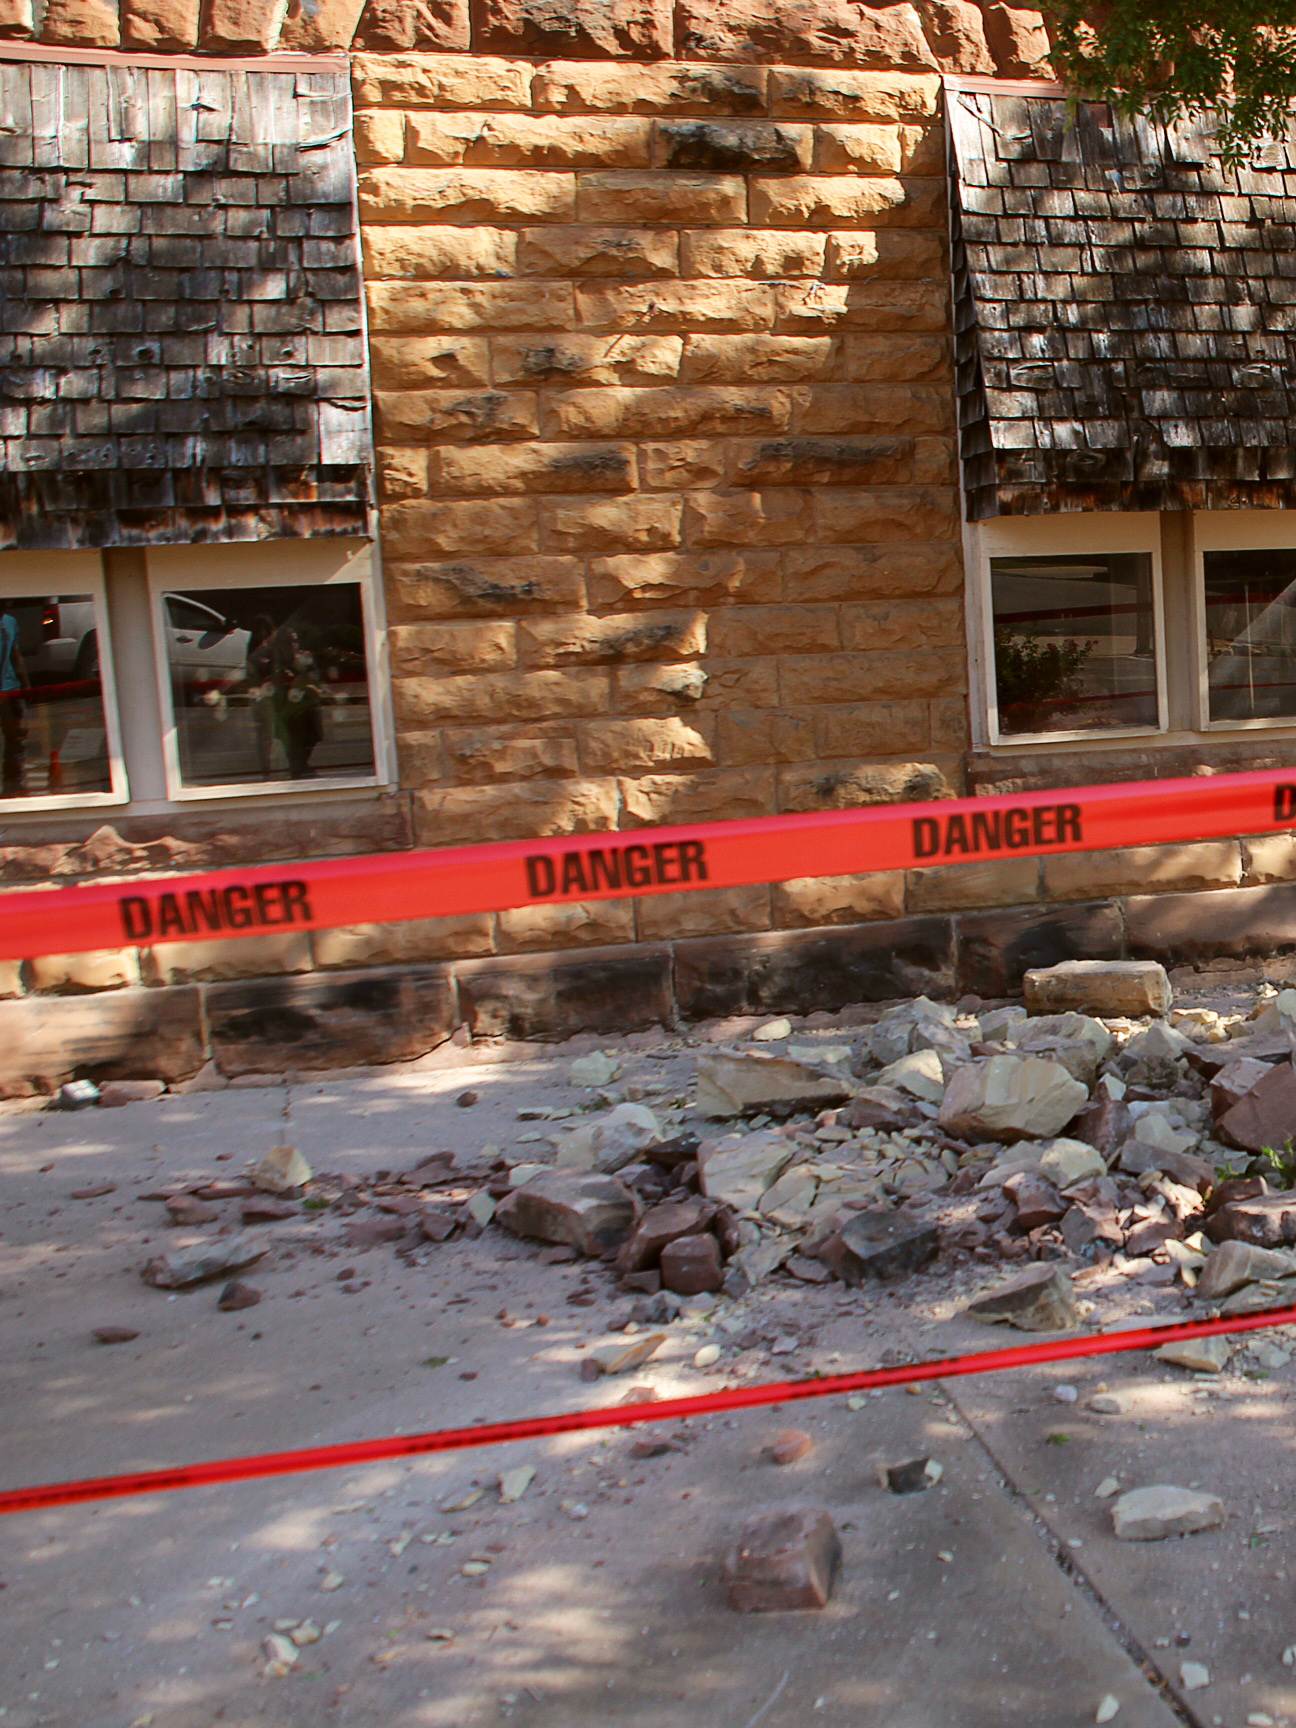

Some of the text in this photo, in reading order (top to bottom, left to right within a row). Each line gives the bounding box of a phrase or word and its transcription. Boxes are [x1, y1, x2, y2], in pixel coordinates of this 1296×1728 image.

[119, 879, 313, 940] DANGER
[525, 839, 709, 898] DANGER
[912, 802, 1083, 859] DANGER
